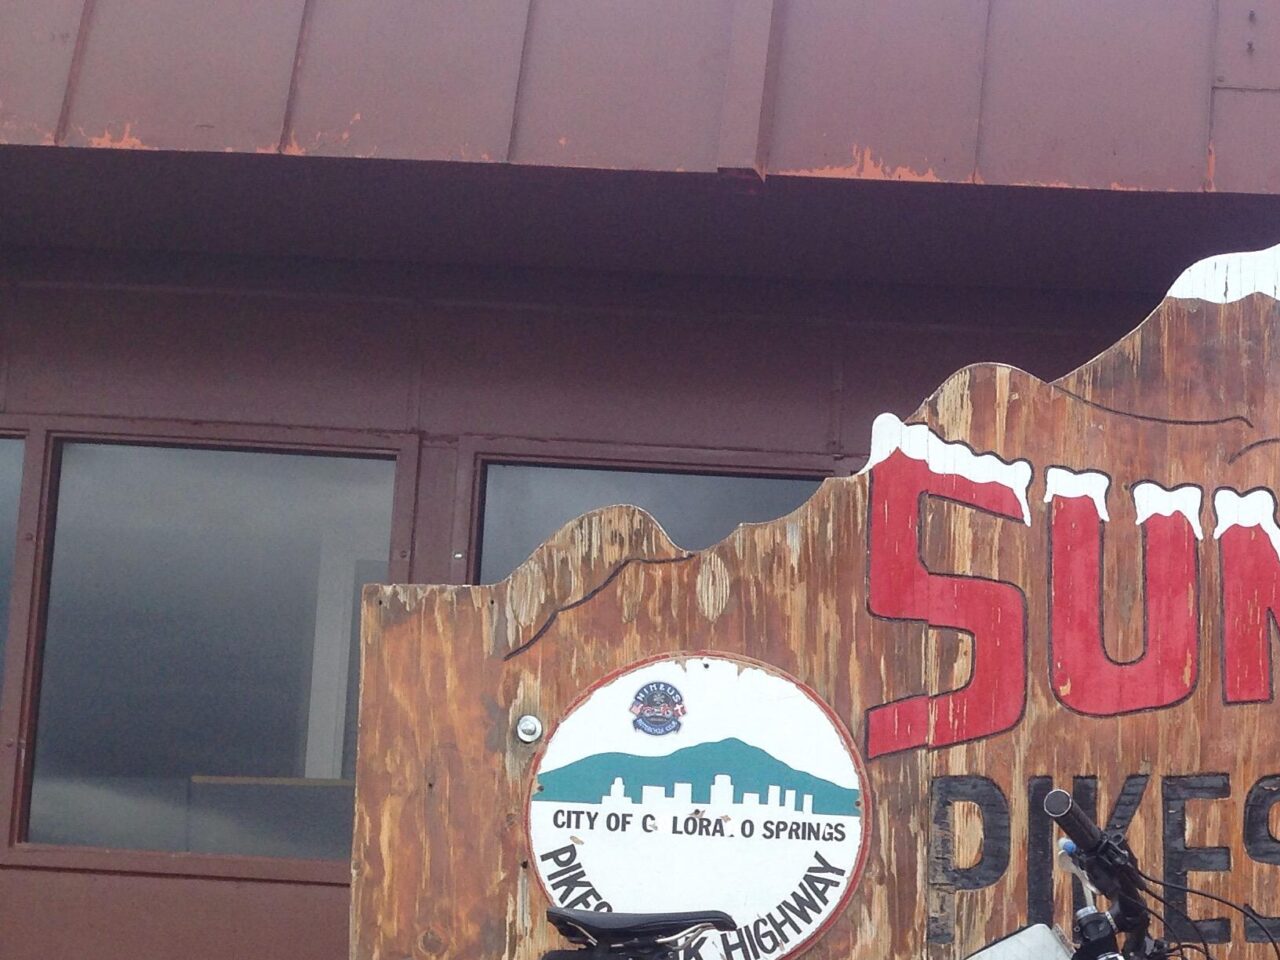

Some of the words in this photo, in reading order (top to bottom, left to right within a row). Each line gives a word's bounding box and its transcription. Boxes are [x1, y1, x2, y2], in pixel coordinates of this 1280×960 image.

[552, 808, 599, 831] CITY
[606, 812, 632, 833] OF
[641, 813, 756, 838] CLORAO
[762, 819, 846, 843] SPRINGS
